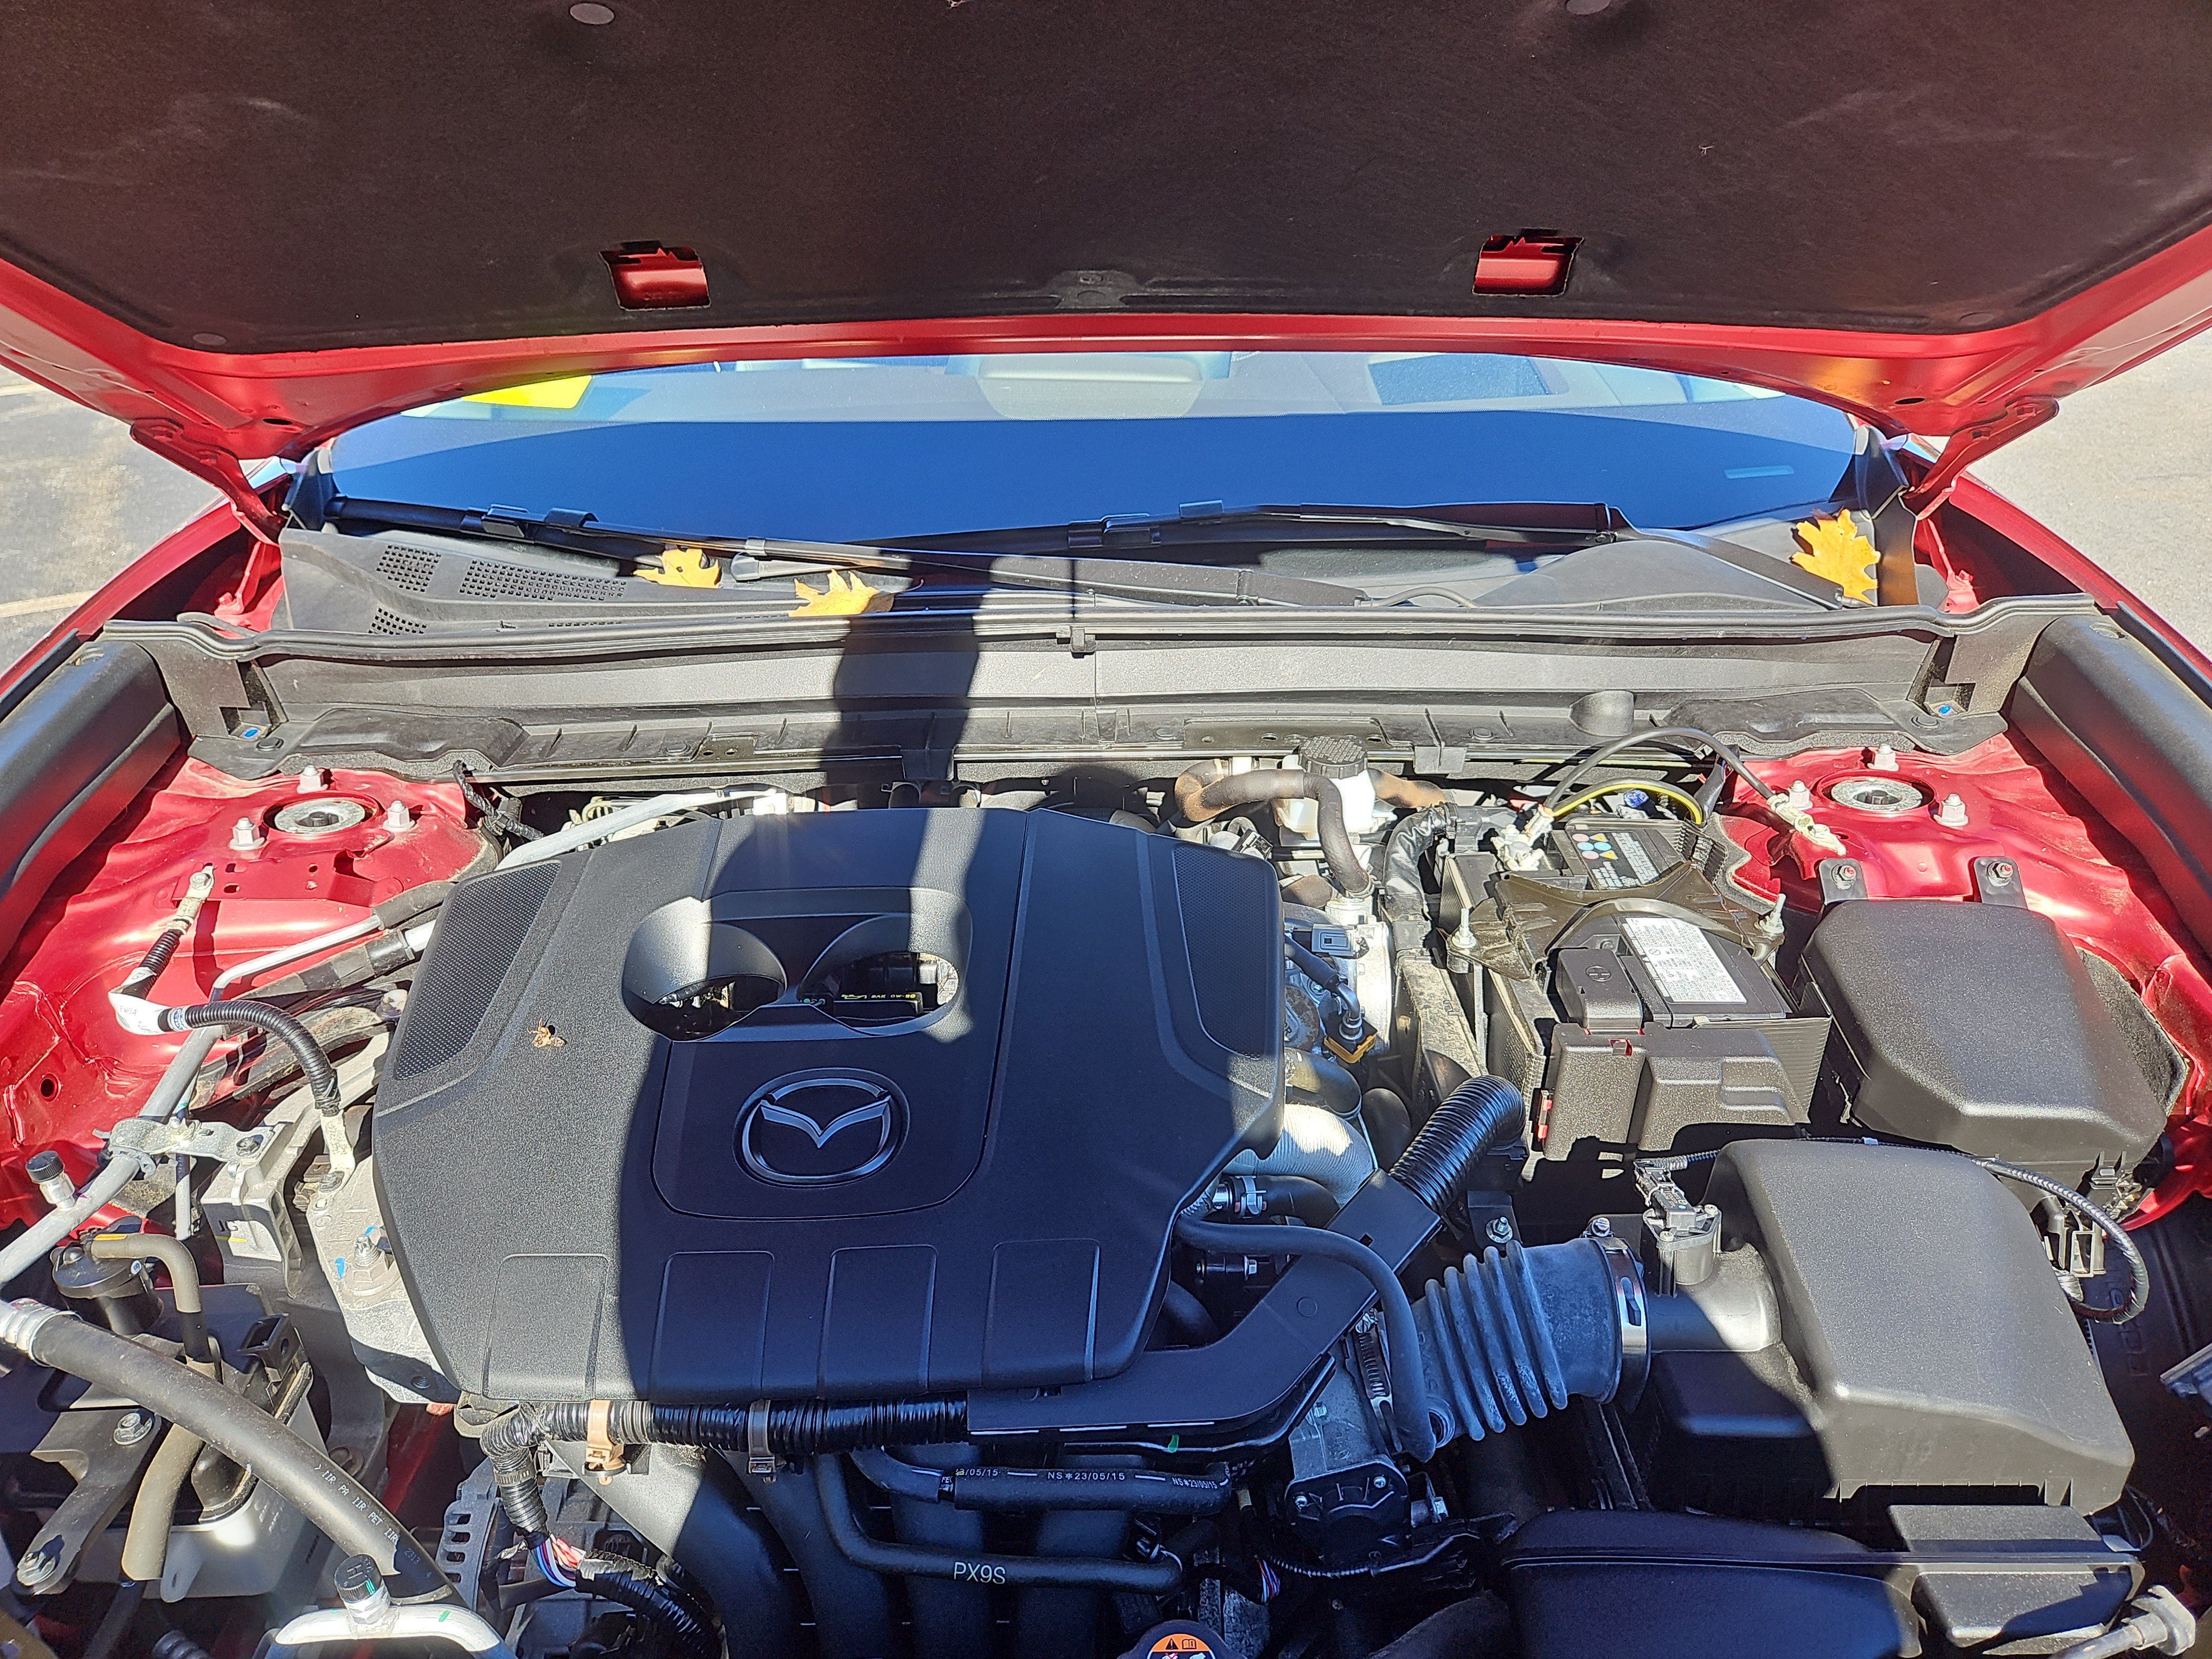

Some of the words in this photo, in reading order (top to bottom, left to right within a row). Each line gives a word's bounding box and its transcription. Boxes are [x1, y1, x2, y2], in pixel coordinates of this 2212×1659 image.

[338, 1484, 350, 1496] PA
[368, 1512, 383, 1526] PET
[954, 1561, 1006, 1585] PX9S
